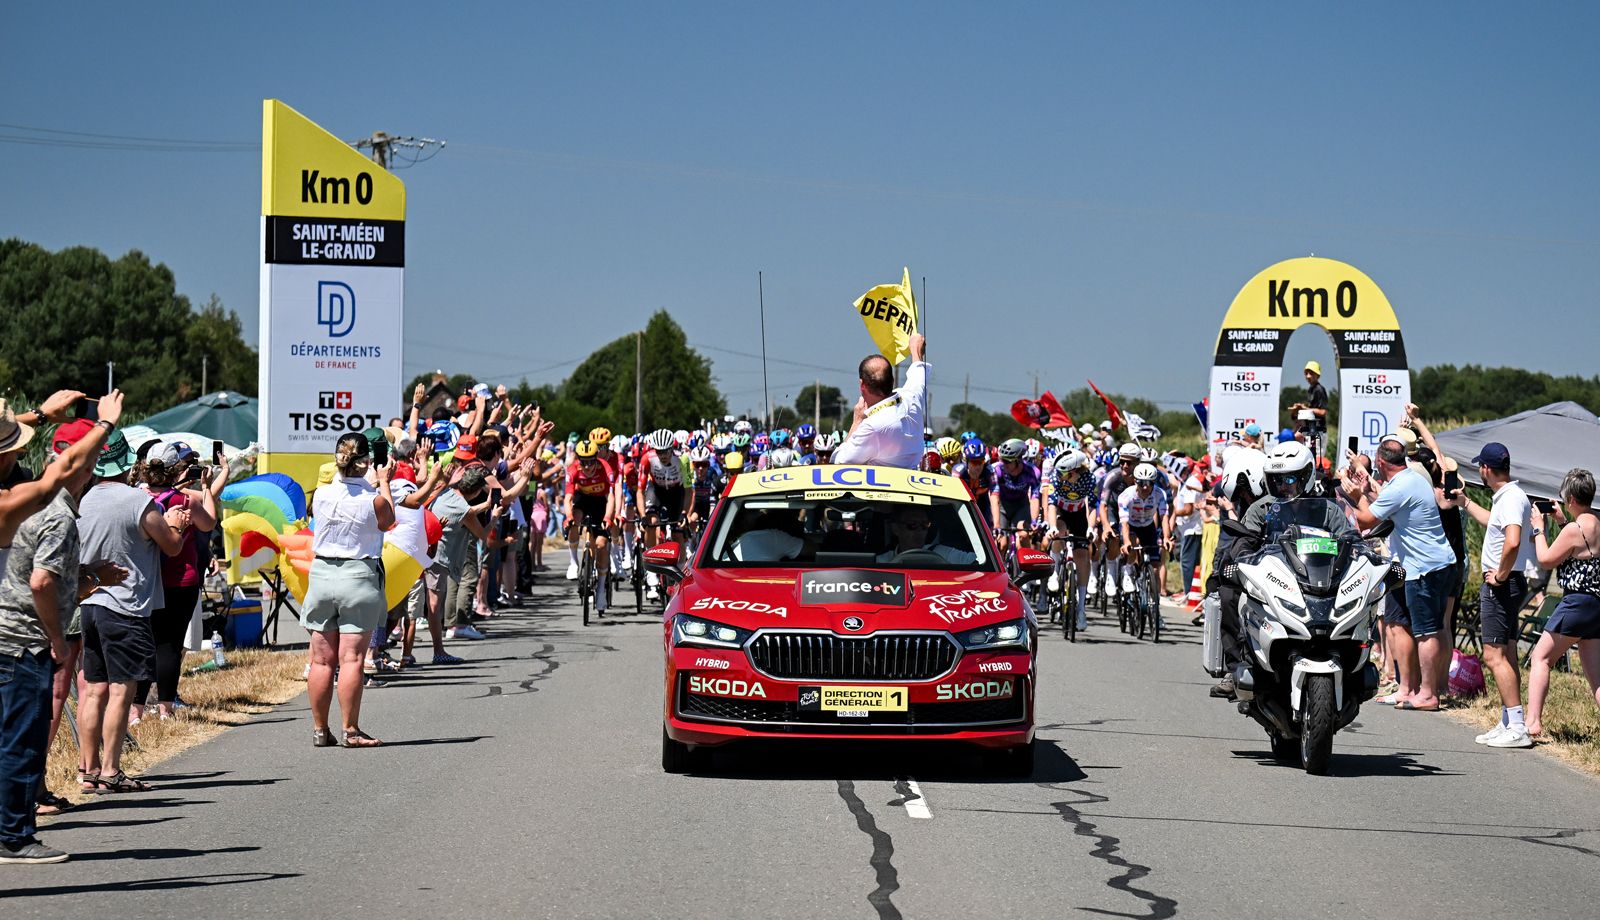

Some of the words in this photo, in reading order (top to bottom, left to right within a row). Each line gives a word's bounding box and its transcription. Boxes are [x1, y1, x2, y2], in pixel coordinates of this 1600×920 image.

[301, 169, 350, 204] Km
[355, 171, 373, 205] 0
[292, 222, 385, 242] SAINT-MÉEN
[302, 242, 376, 260] LE-GRAND
[1268, 279, 1329, 318] Km
[1336, 280, 1358, 318] 0
[1227, 329, 1279, 340] SAINT-MÉEN
[1344, 330, 1395, 342] SAINT-MÉEN
[291, 341, 381, 358] DÉPARTEMENTS
[1233, 342, 1274, 352] LE-GRAND
[1349, 343, 1390, 354] LE-GRAND
[315, 360, 325, 369] DE
[327, 360, 357, 369] FRANCE
[1221, 382, 1270, 392] TISSOT
[1353, 385, 1402, 394] TISSOT
[289, 413, 381, 431] TISSOT
[1216, 431, 1274, 442] TIST
[761, 473, 794, 483] LCL
[812, 467, 891, 487] LCL
[910, 475, 942, 487] LCL
[695, 657, 730, 670] HYBRID
[978, 662, 1013, 673] HYBRID
[690, 676, 767, 698] SKODA
[936, 681, 1013, 700] SKODA
[824, 690, 883, 698] DIRECTION
[890, 691, 902, 707] 1
[824, 697, 882, 707] GÉNÉRALE
